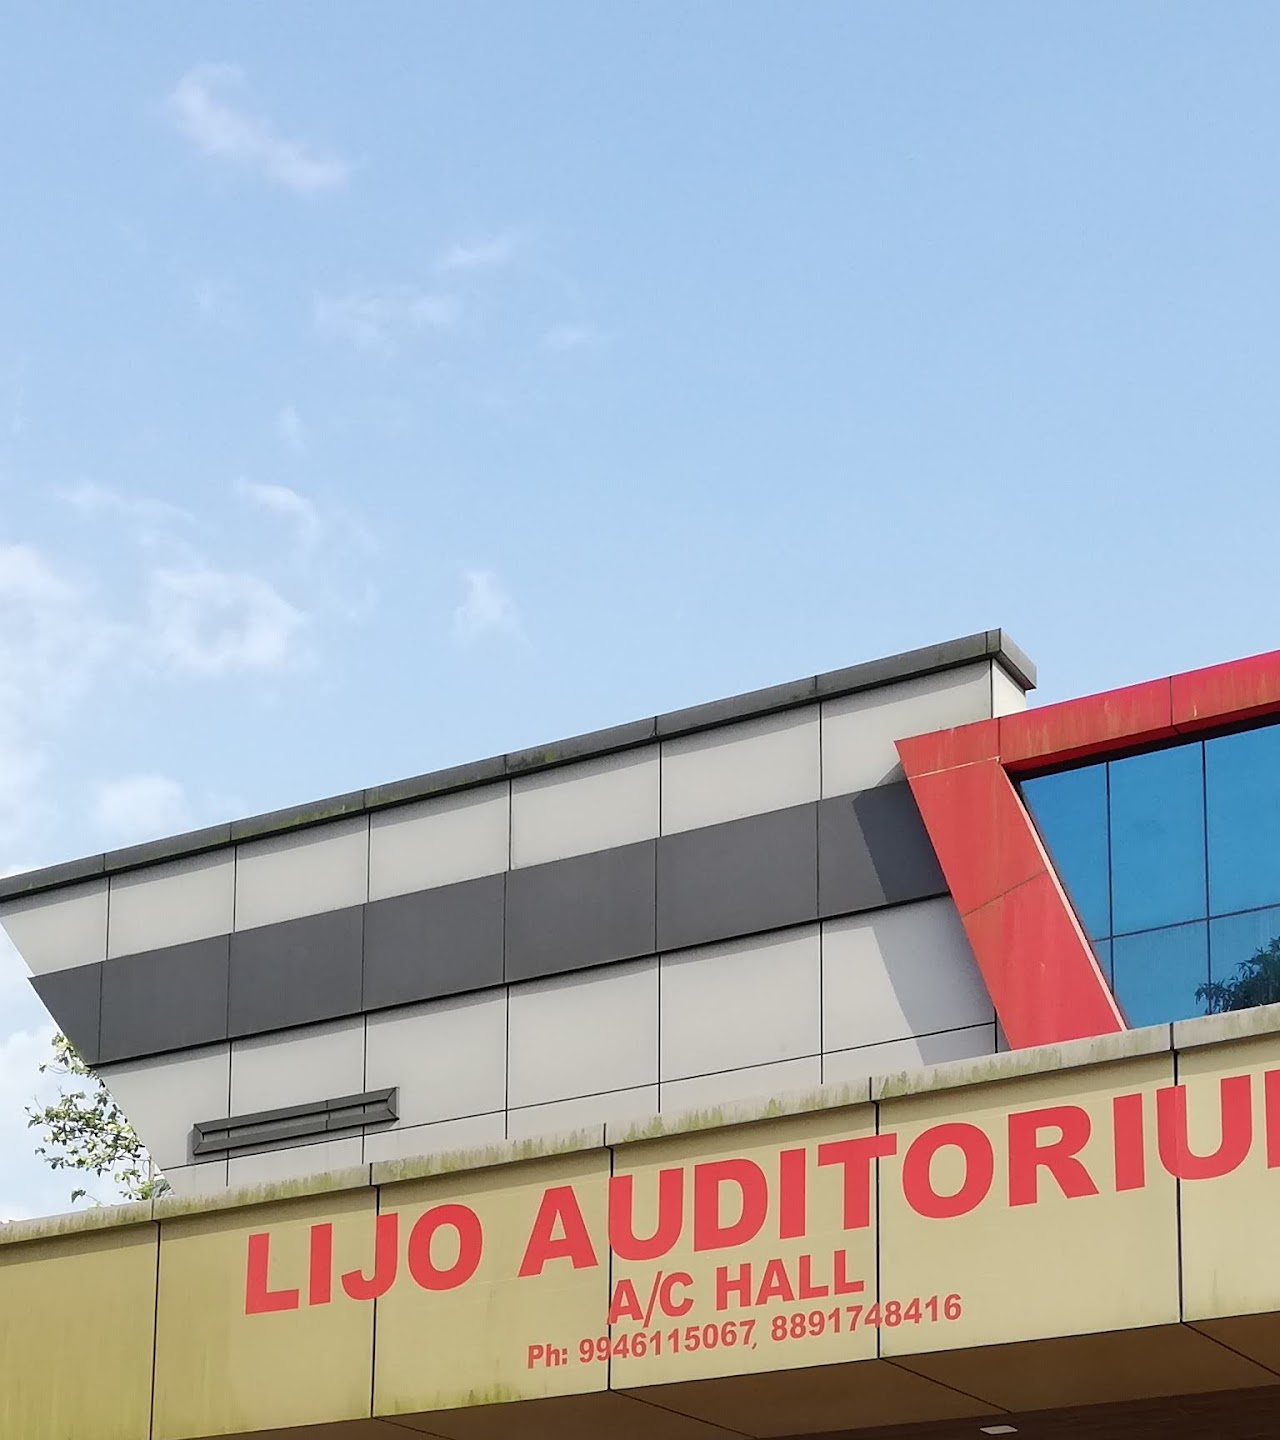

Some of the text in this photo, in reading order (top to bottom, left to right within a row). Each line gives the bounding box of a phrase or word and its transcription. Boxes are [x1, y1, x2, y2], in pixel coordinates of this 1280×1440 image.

[245, 1203, 483, 1315] LIJO
[606, 1249, 865, 1328] A/C HALL
[527, 1294, 963, 1369] Ph: 9946115067, 8891748416
